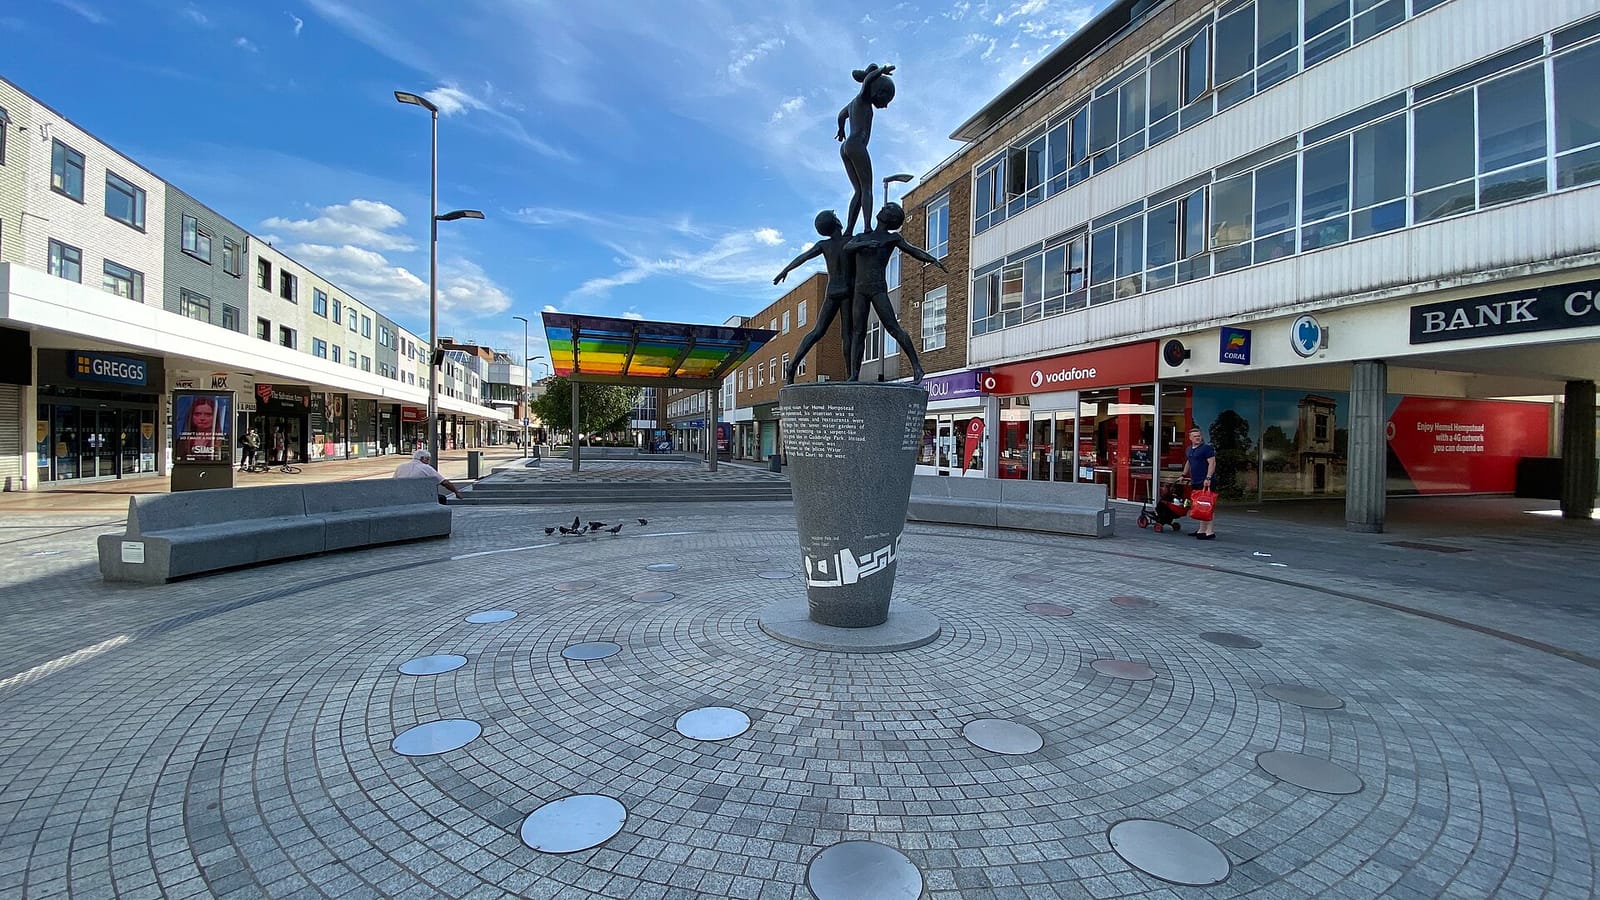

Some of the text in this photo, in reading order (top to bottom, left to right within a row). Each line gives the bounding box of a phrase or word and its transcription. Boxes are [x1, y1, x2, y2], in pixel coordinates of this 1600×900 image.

[1422, 297, 1539, 334] BANK
[1224, 352, 1246, 360] CORAL
[92, 359, 144, 380] GREGGS
[1045, 367, 1097, 383] vodafone
[924, 381, 949, 397] illow
[1416, 422, 1485, 434] Enjoy Hemel Hempstead
[1435, 433, 1449, 442] with
[1453, 434, 1461, 442] 4G
[1461, 434, 1484, 442] network
[1433, 445, 1445, 454] you
[1455, 444, 1477, 454] depend
